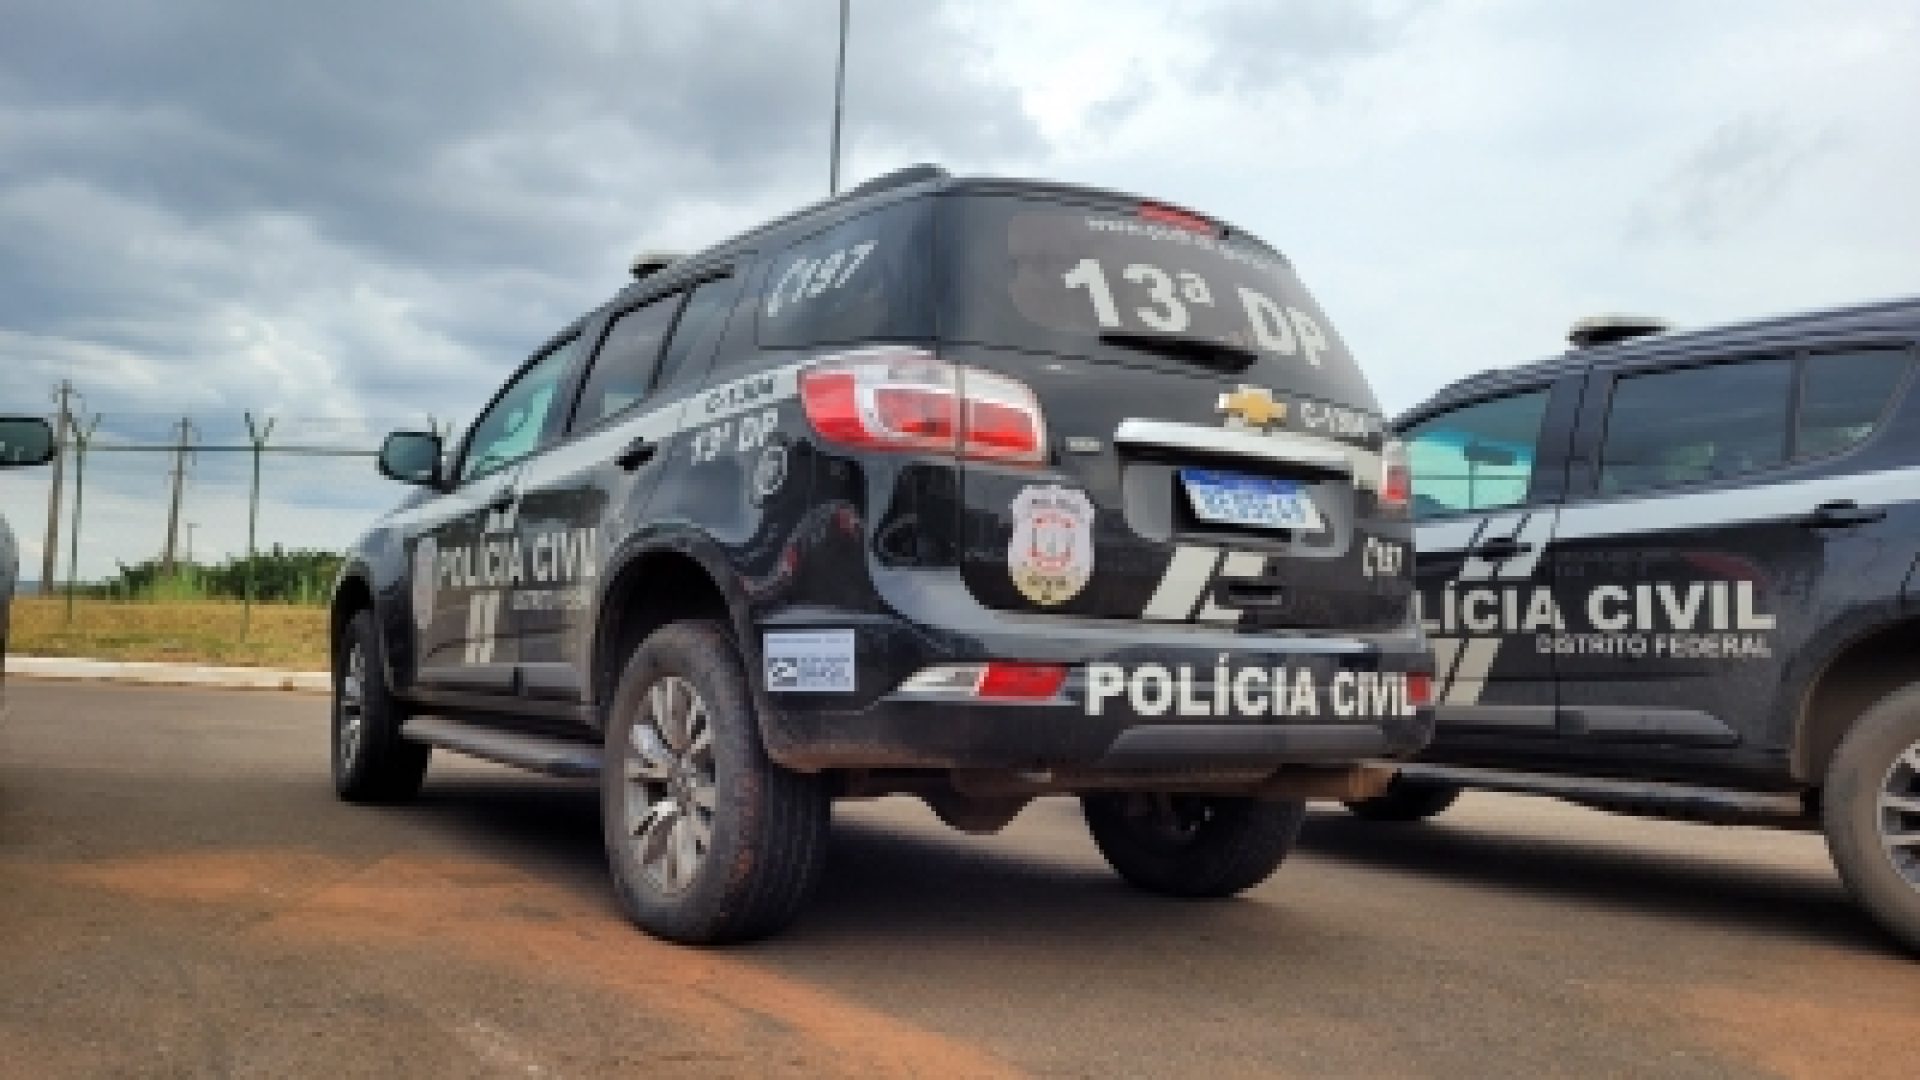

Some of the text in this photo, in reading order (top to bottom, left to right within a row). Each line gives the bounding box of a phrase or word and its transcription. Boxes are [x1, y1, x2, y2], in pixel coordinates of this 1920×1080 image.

[1237, 287, 1329, 368] DP
[738, 408, 779, 452] DP
[532, 527, 596, 582] CIVIL
[1412, 580, 1777, 631] LÍCIA CIVIL
[1535, 632, 1773, 659] DISTRITO FEDERAL
[1085, 652, 1417, 717] POLÍCIA CIVIL
